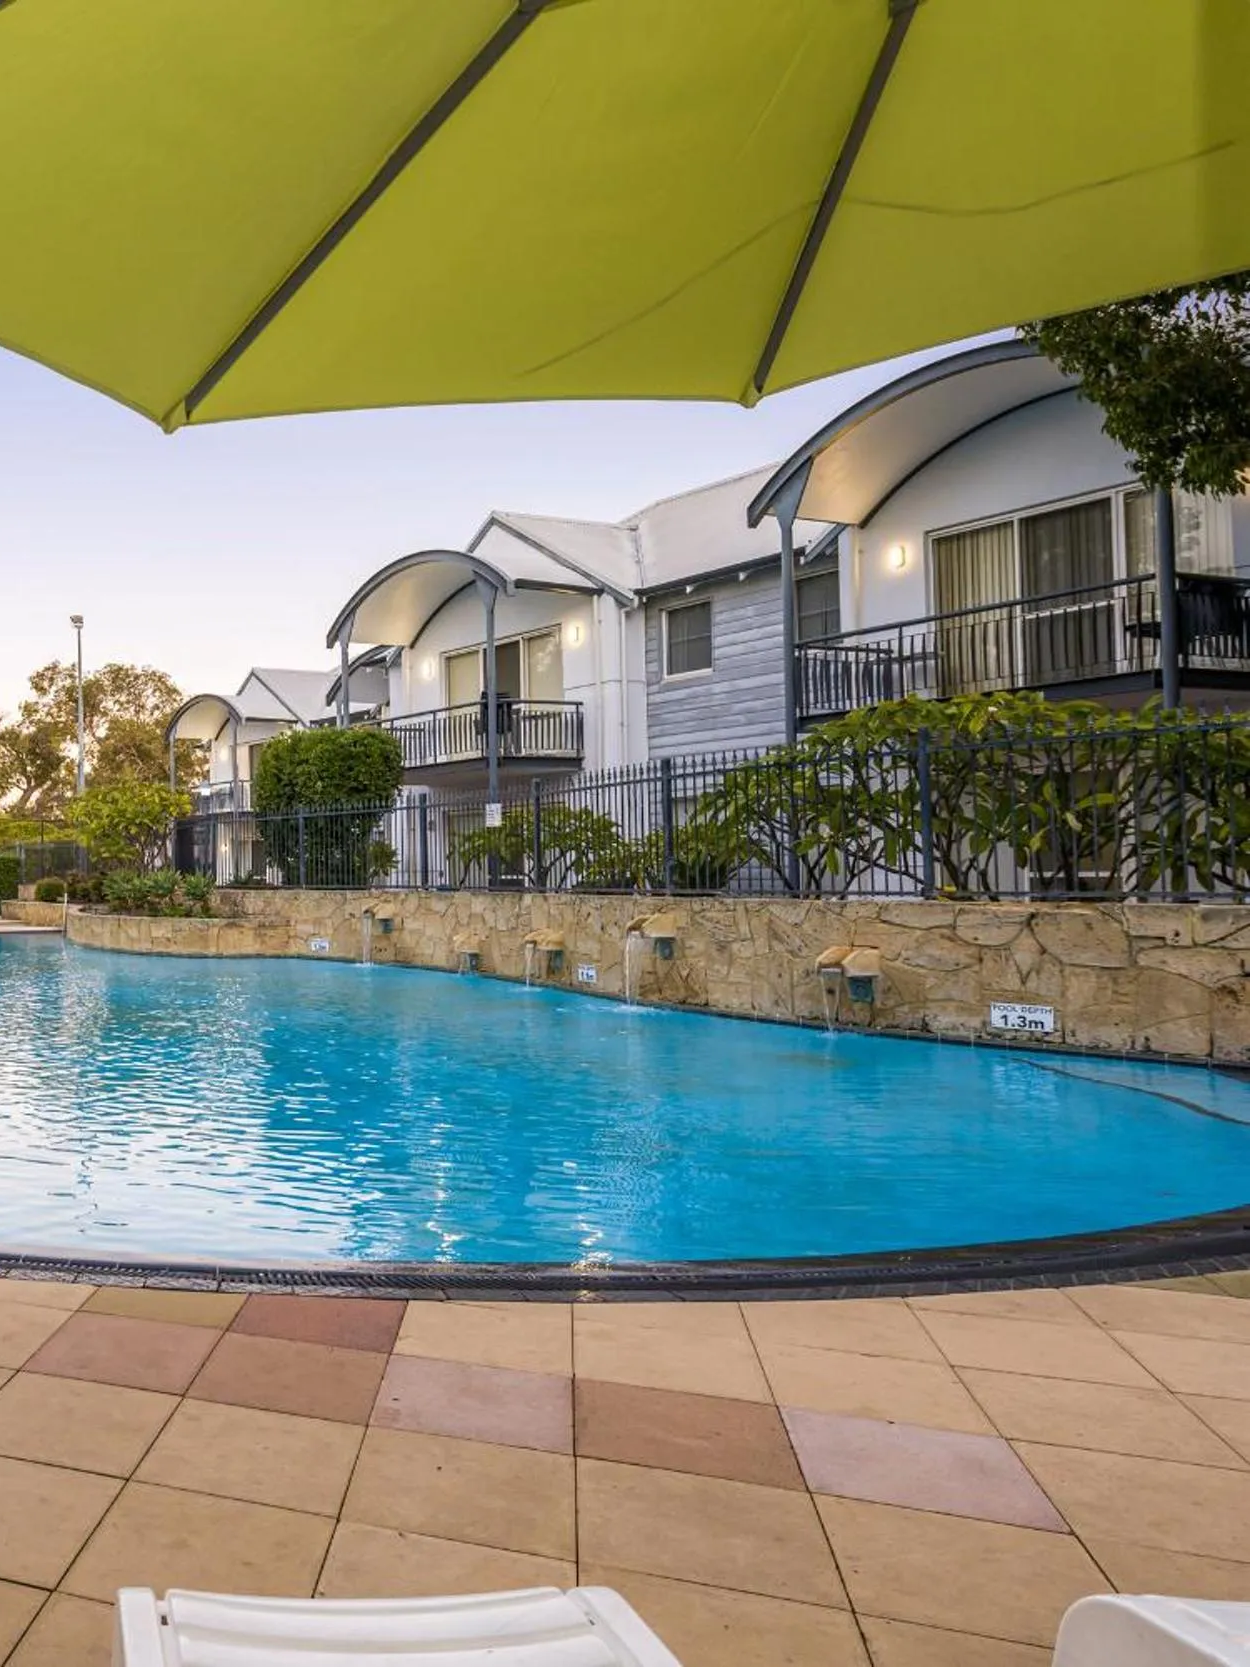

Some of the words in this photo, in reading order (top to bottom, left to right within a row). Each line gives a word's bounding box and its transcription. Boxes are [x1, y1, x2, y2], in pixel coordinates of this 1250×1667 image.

[993, 1004, 1018, 1013] POOL
[1021, 1006, 1052, 1014] DEPTH
[1000, 1014, 1044, 1029] 1.3m
